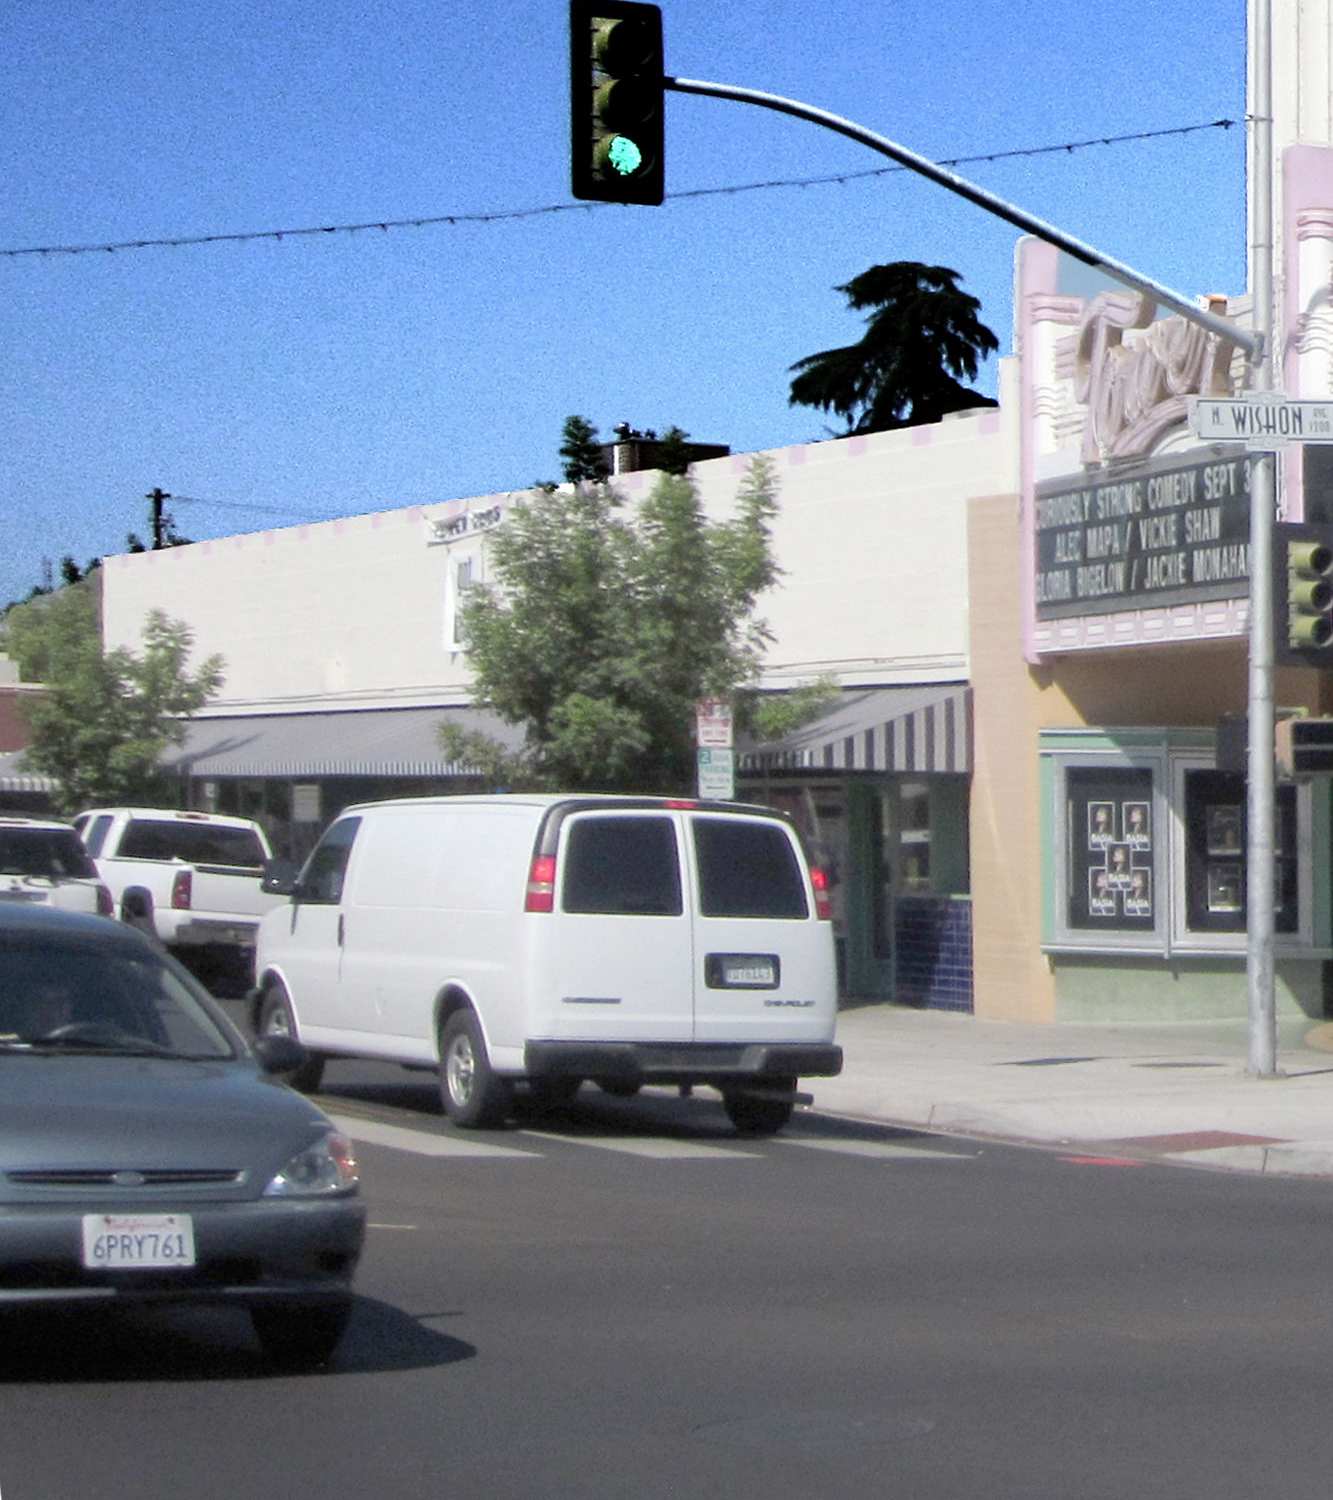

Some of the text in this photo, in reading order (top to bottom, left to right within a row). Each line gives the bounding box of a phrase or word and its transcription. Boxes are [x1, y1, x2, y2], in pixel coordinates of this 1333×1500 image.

[1231, 406, 1303, 435] WISHON
[1097, 481, 1142, 519] STRONG
[1148, 470, 1197, 510] COMEDY
[1203, 462, 1237, 500] SEPT
[1086, 524, 1120, 559] MAPA
[1139, 513, 1178, 550] VICKIE
[1185, 506, 1221, 543] SHAW
[1144, 552, 1187, 590] JACKIE
[93, 1234, 188, 1259] 6PRY761
